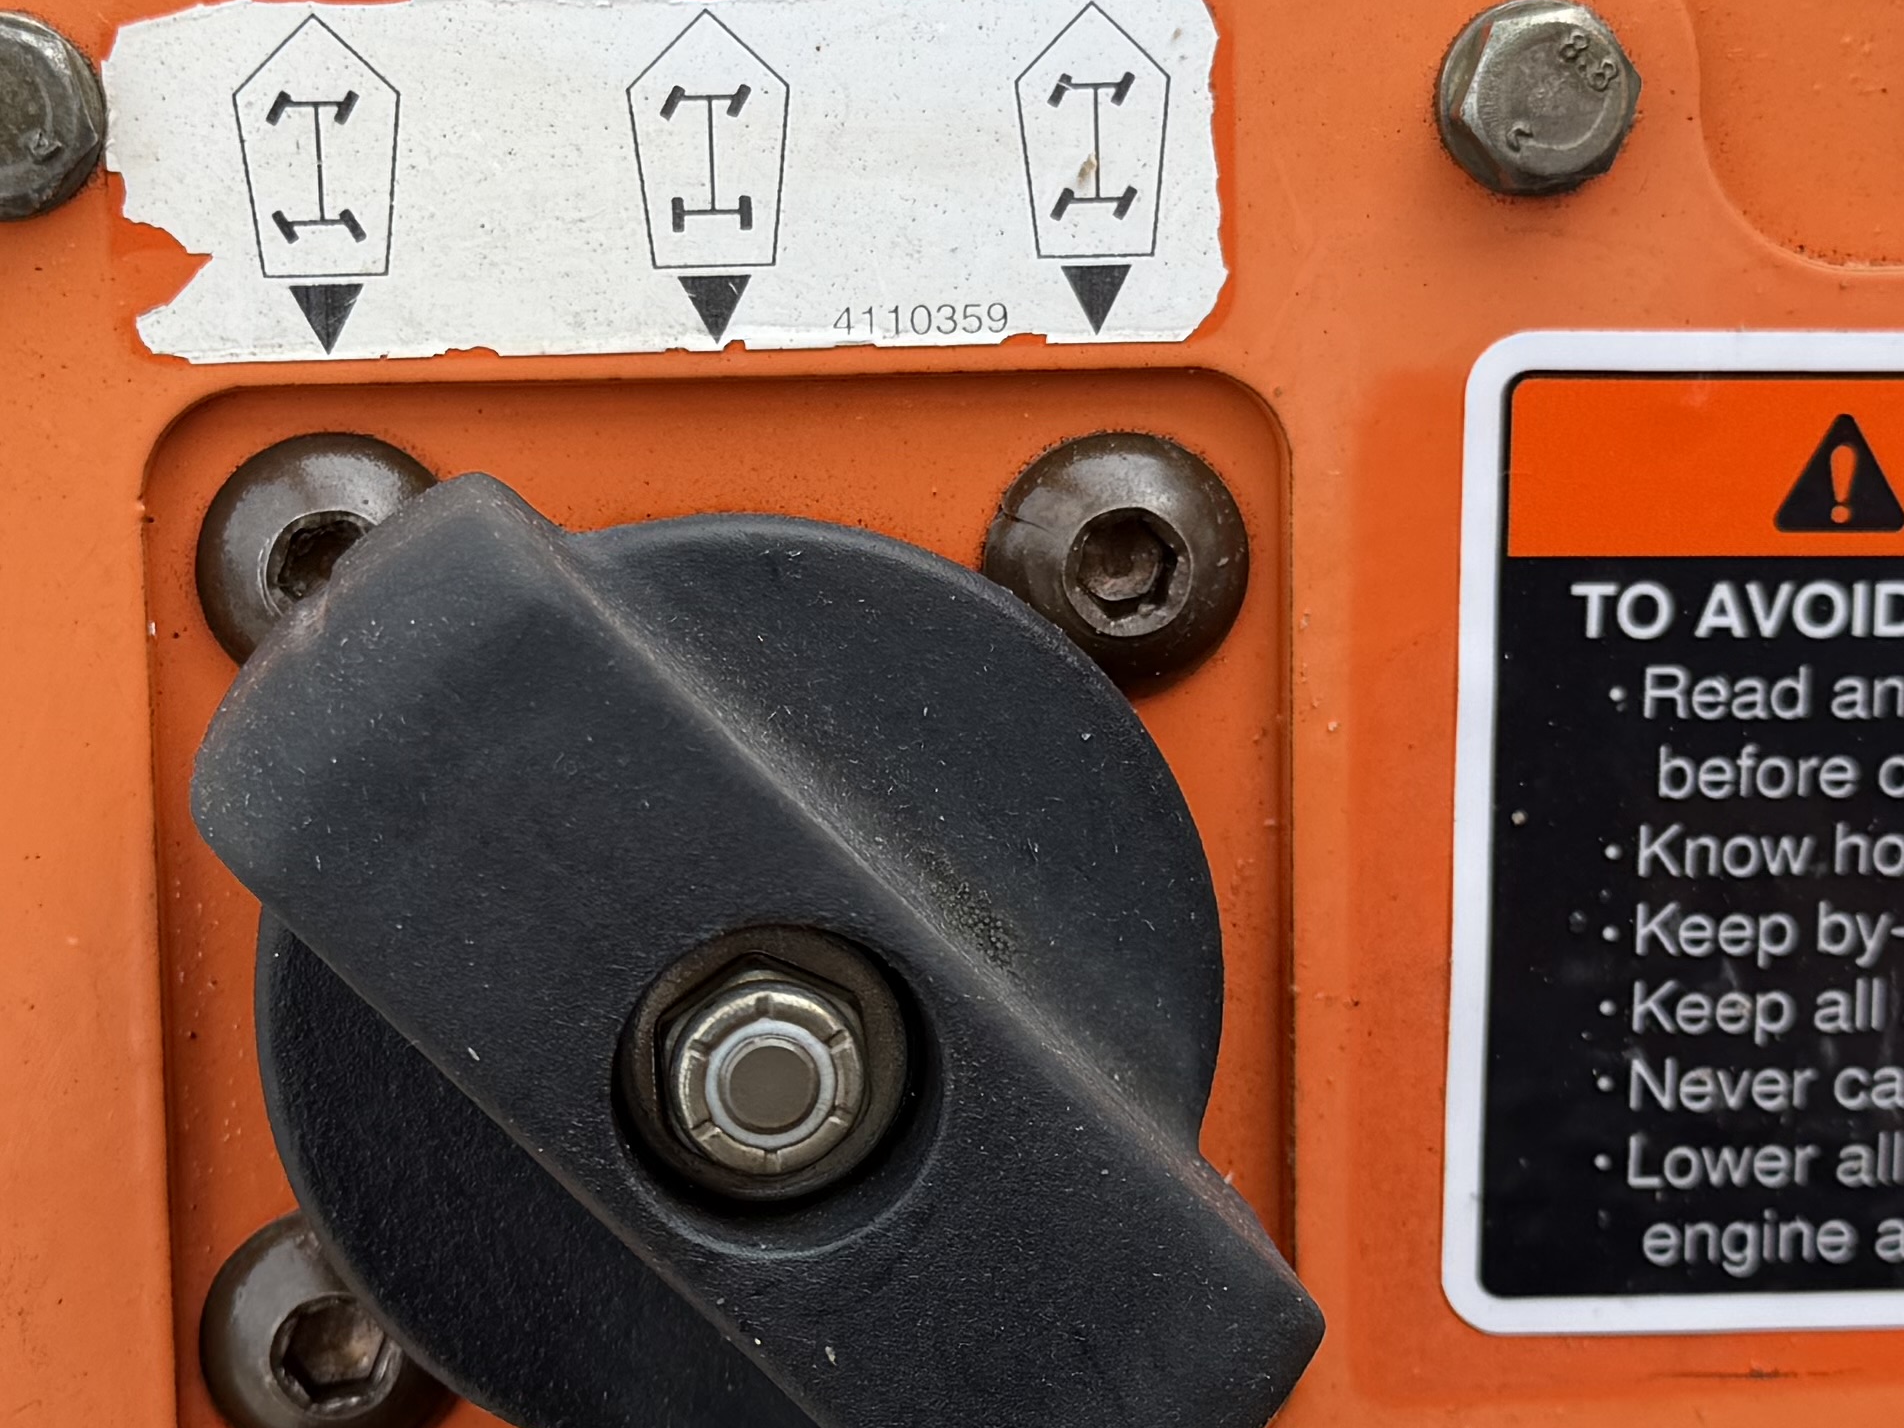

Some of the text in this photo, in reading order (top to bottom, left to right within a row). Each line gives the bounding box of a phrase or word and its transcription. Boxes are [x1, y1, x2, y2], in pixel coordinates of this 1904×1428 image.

[832, 302, 1009, 336] 4110359
[1571, 581, 1676, 640] TO
[1642, 665, 1813, 720] Read
[1658, 744, 1858, 799] before
[1637, 824, 1816, 878] Know
[1634, 902, 1799, 968] Keep
[1631, 980, 1797, 1046] Keep
[1813, 977, 1890, 1032] all
[1628, 1057, 1818, 1112] Never
[1627, 1132, 1821, 1189] Lower
[1641, 1209, 1858, 1277] engine
